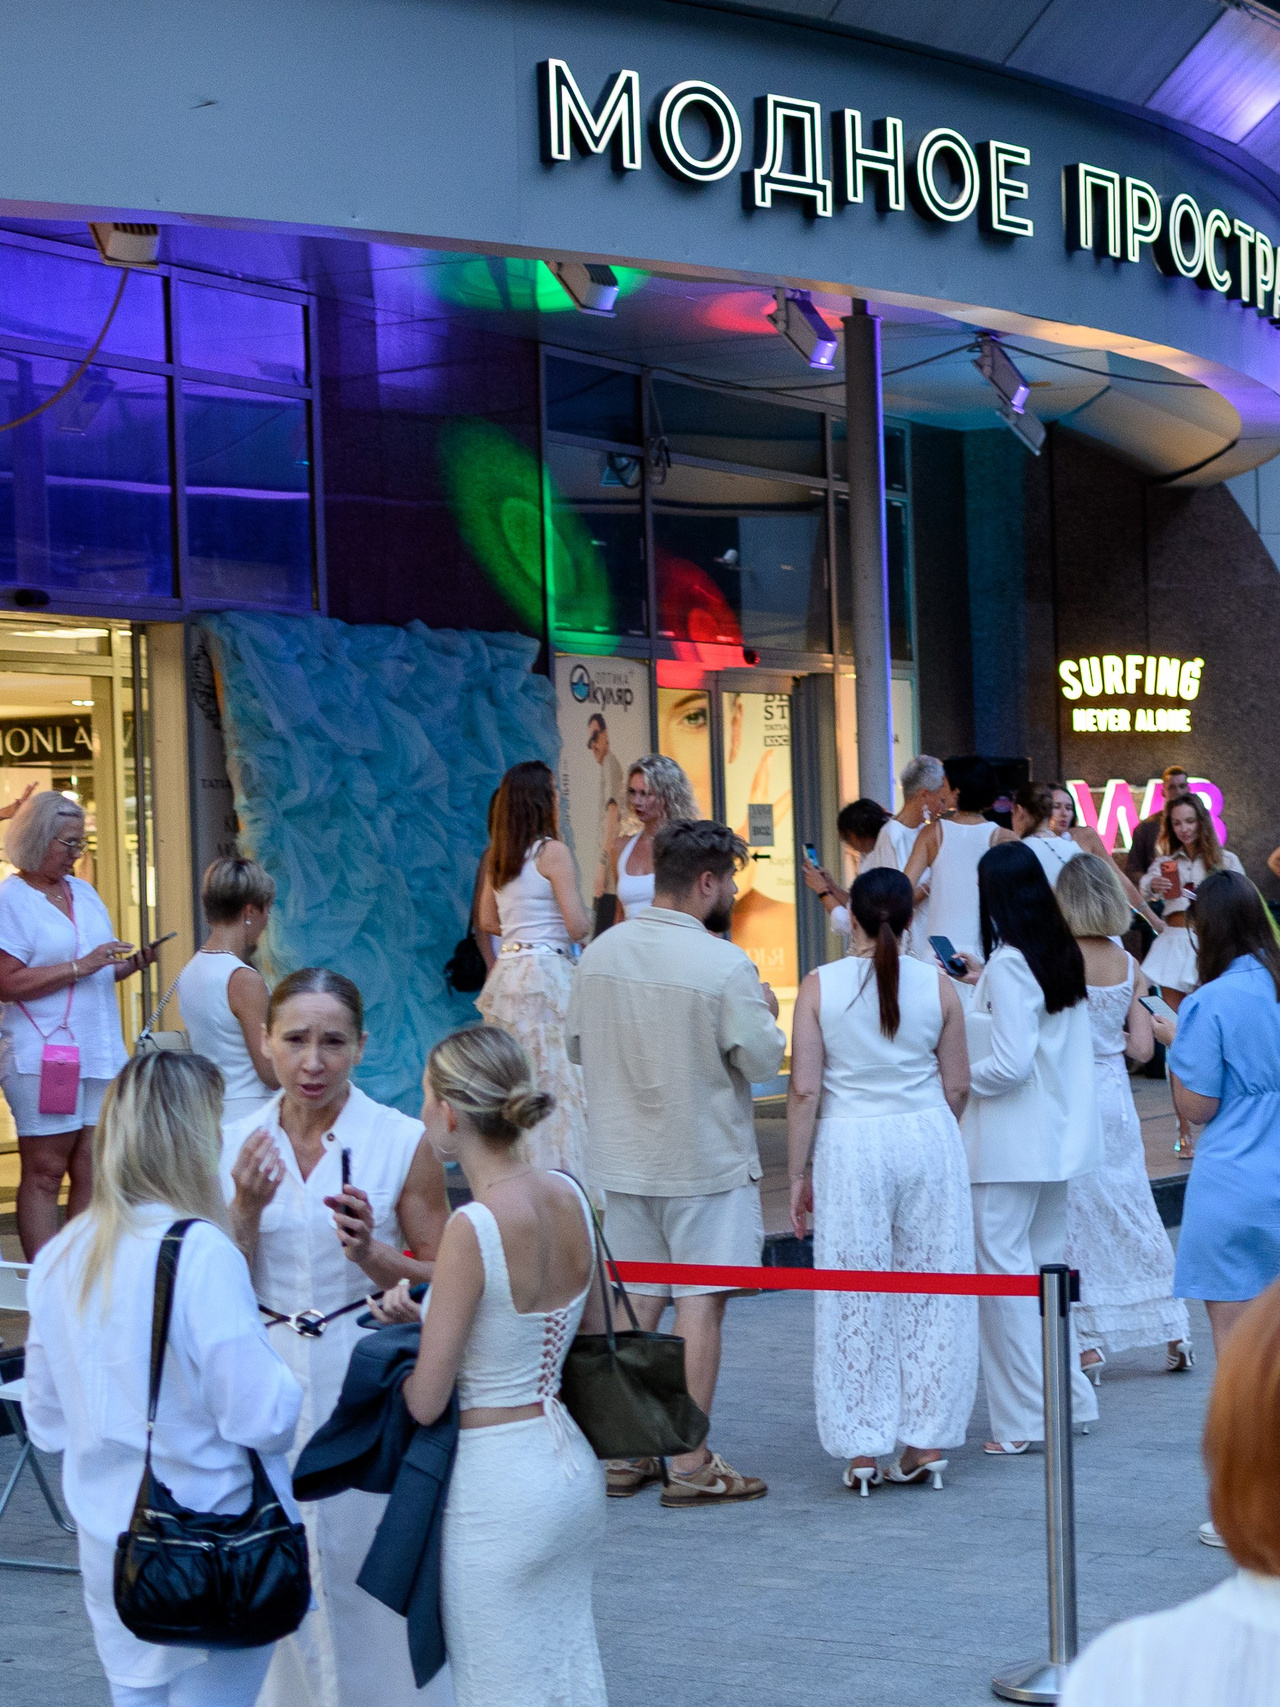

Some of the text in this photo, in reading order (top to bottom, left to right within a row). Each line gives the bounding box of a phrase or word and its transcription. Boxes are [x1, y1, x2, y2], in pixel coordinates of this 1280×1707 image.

[540, 57, 1034, 237] МОДНОЕ
[1059, 655, 1204, 700] SURFING
[1073, 708, 1192, 732] NEVER ALONE
